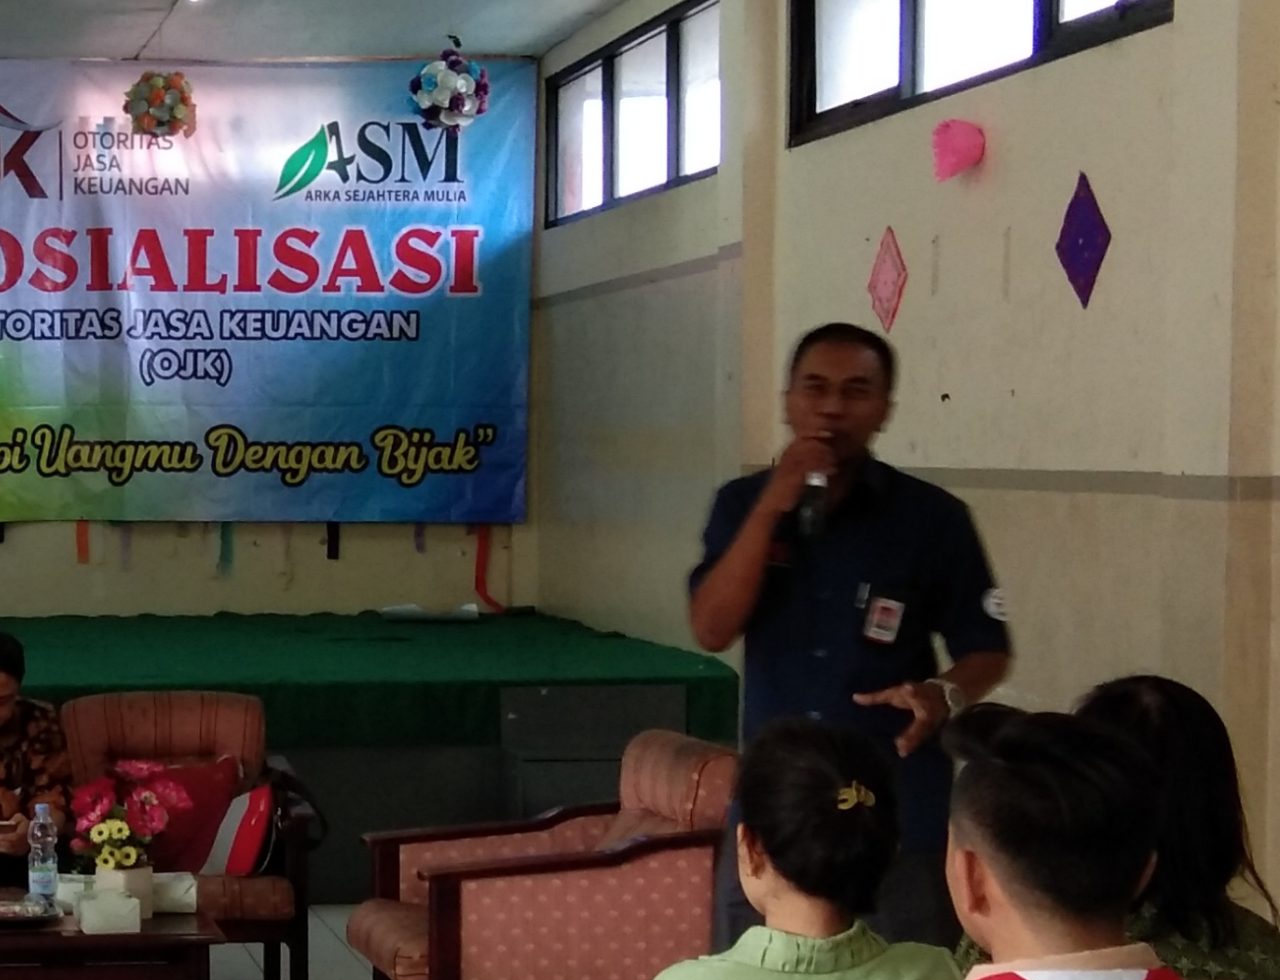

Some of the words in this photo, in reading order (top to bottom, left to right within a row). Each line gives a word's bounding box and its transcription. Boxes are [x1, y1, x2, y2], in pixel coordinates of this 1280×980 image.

[72, 131, 174, 151] OTORITAS
[324, 120, 465, 185] ASM
[72, 154, 121, 173] JASA
[72, 177, 191, 196] KEUANGAN
[305, 189, 341, 202] ARKA
[345, 189, 419, 202] SEJAHTERA
[423, 189, 467, 202] MULIA
[127, 309, 211, 341] JASA
[221, 309, 419, 341] KEUANGAN
[140, 349, 232, 386] (OJK)
[31, 424, 203, 487] Uangmu
[205, 424, 369, 487] Dengan
